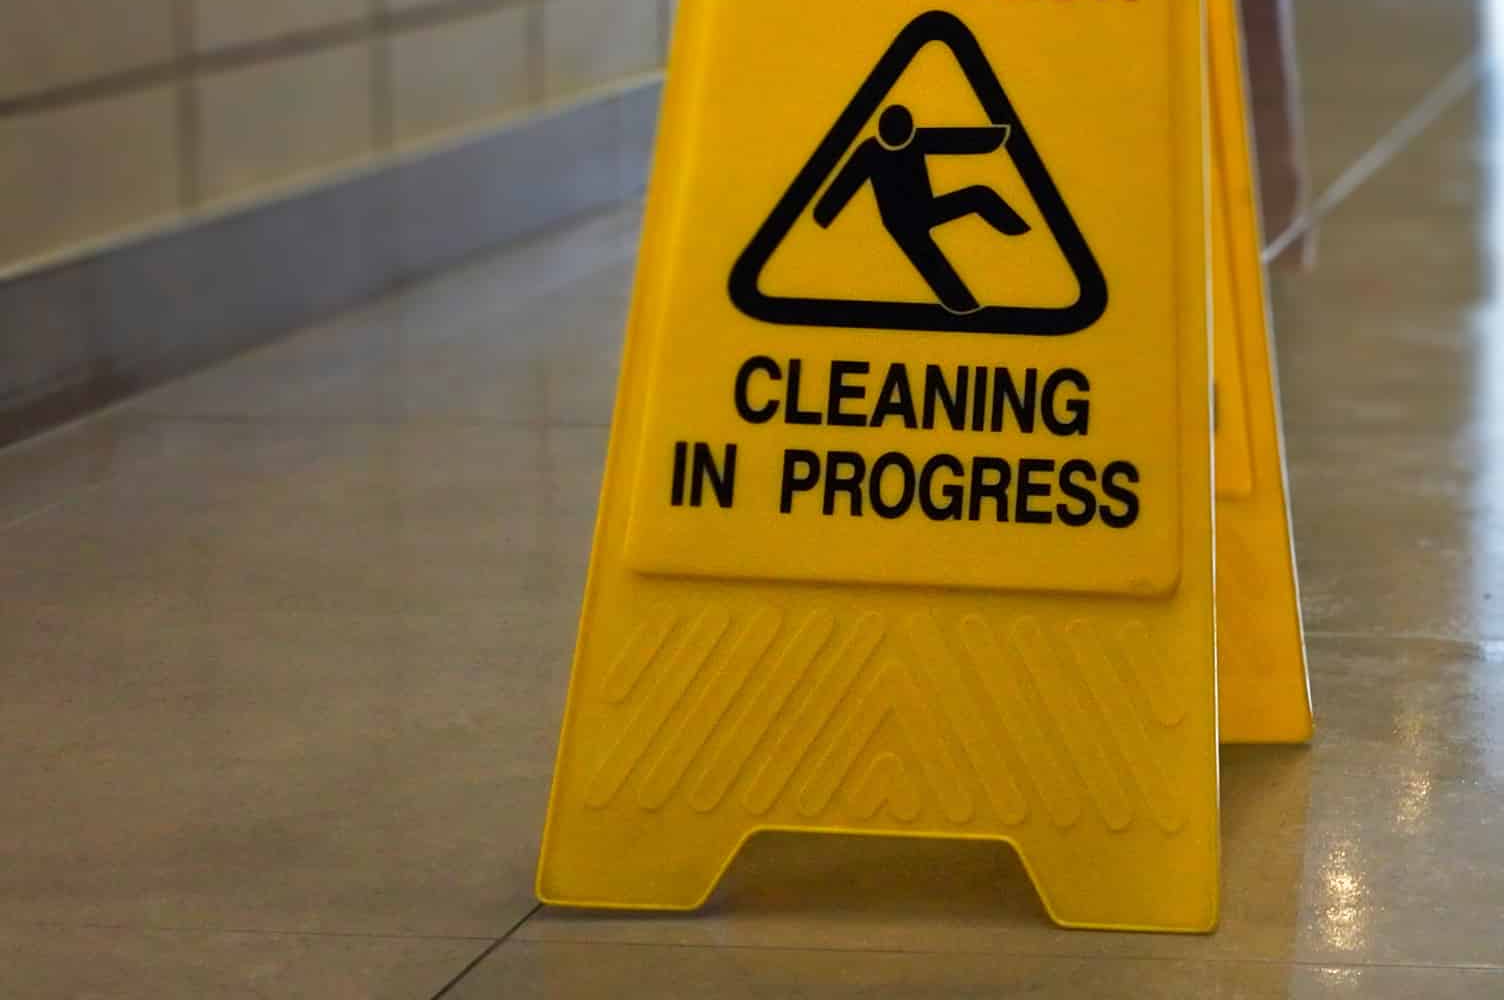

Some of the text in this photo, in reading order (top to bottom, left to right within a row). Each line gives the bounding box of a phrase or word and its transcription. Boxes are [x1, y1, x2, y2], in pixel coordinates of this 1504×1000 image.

[733, 355, 1090, 436] CLEANING
[670, 441, 1141, 529] IN PROGRESS
